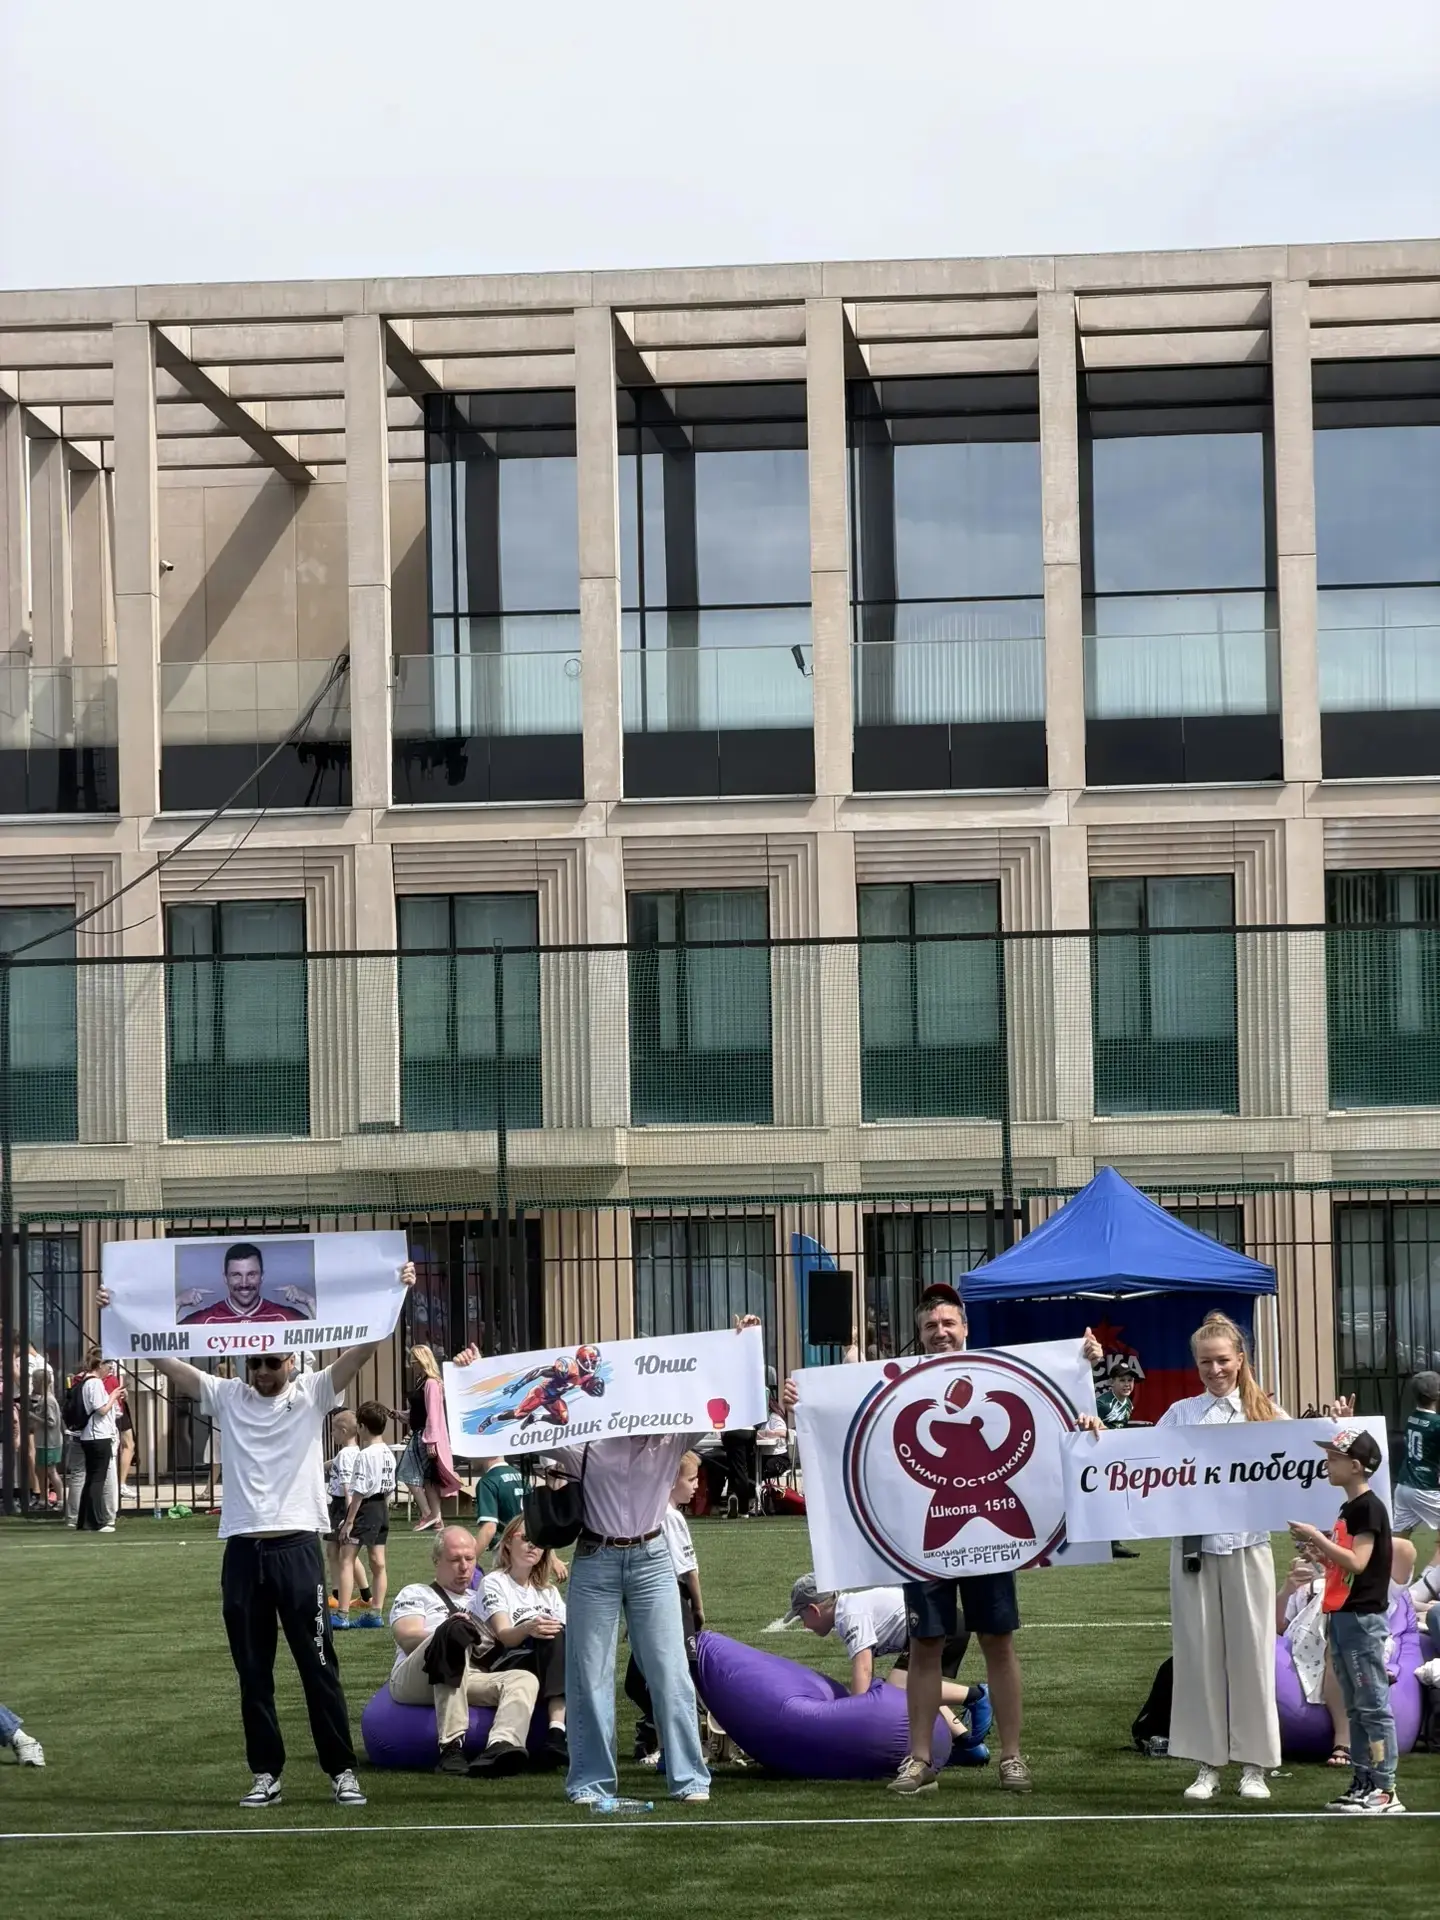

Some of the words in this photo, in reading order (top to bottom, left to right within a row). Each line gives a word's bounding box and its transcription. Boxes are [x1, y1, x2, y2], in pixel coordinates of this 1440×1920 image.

[131, 1331, 190, 1351] РОМАН
[206, 1333, 275, 1353] супер
[283, 1325, 353, 1346] КАПИТАН
[634, 1355, 697, 1375] Юнис
[510, 1419, 602, 1447] соперник
[607, 1410, 694, 1431] берегись
[899, 1443, 948, 1486] Олимп
[952, 1429, 1032, 1488] Останкино
[1104, 1456, 1198, 1498] Верой
[1204, 1466, 1221, 1485] к
[1229, 1451, 1329, 1488] победе
[930, 1504, 977, 1518] Школа
[984, 1497, 1017, 1512] 1518
[923, 1547, 967, 1559] ШКОЛЬНЫЙ
[968, 1542, 1017, 1554] СПОРТИВНЫЙ
[1018, 1540, 1038, 1548] КЛУБ
[941, 1548, 1021, 1568] ТЭГ-РЕГБИ
